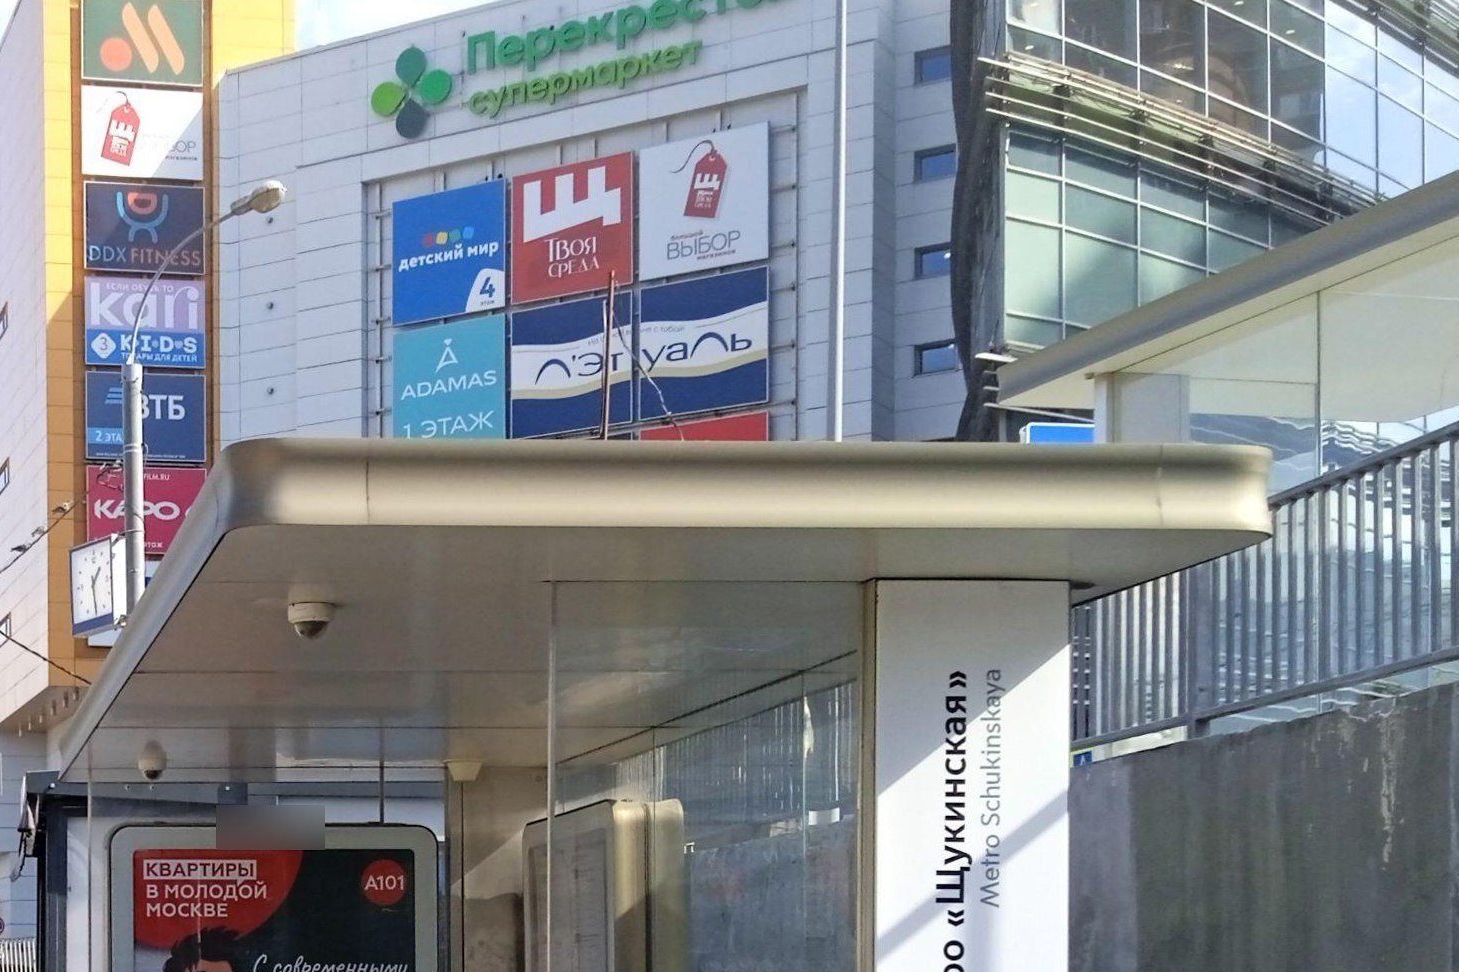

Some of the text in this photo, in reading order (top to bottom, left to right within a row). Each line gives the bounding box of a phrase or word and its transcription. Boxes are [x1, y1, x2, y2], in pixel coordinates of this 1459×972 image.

[467, 0, 786, 74] Перекрес
[469, 40, 703, 118] супермаркет
[523, 165, 621, 243] Щ
[89, 245, 201, 267] DDX FITNESS
[398, 241, 499, 272] детский мир
[666, 230, 741, 260] ВЫБОР
[547, 256, 600, 278] СРЕДА
[479, 276, 496, 298] 4
[91, 282, 200, 330] kari
[99, 336, 109, 350] 3
[121, 352, 153, 361] ТОАРЫ
[401, 370, 497, 400] ADAMAS
[95, 430, 123, 443] 2 ЭТА
[403, 410, 494, 439] 1 ЭТАЖ
[935, 670, 973, 927] «Щукинская»
[979, 669, 1006, 908] Metro Schukinskaya
[146, 862, 254, 877] КВАРТИРЫ
[146, 880, 267, 902] В МОЛОДОЙ
[146, 902, 228, 918] МОСКВЕ
